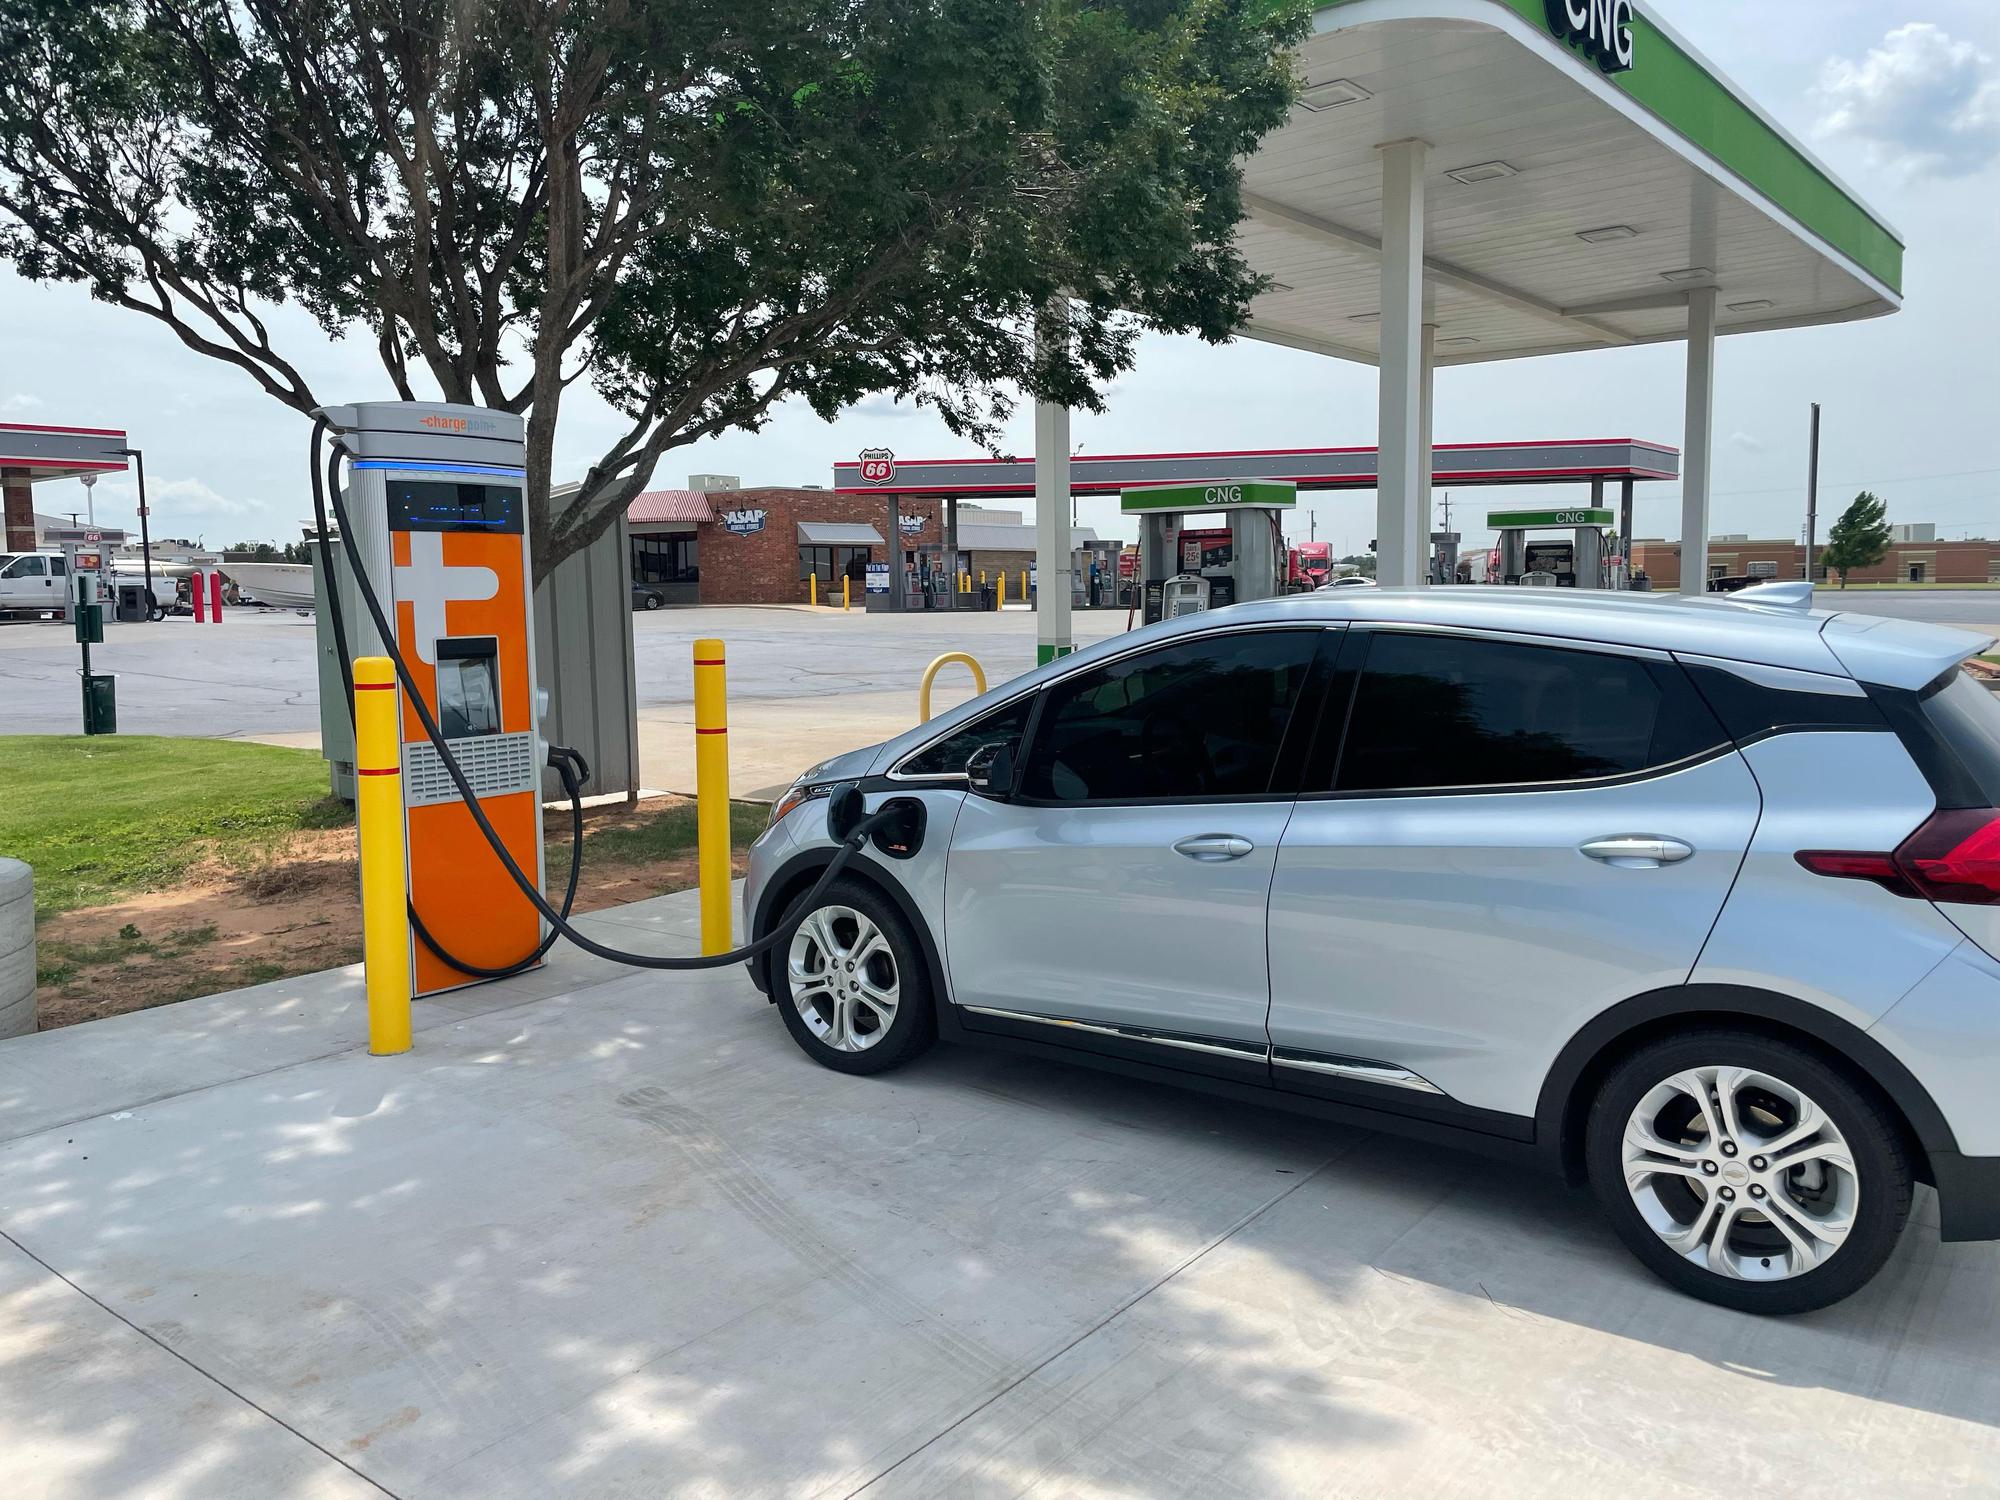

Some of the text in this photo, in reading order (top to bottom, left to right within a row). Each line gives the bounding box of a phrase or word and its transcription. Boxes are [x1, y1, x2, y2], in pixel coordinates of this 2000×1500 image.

[1565, 0, 1633, 69] CNG
[865, 462, 888, 477] 66
[1205, 486, 1242, 504] CNG
[727, 510, 764, 524] ASAP
[1555, 512, 1585, 523] CNG
